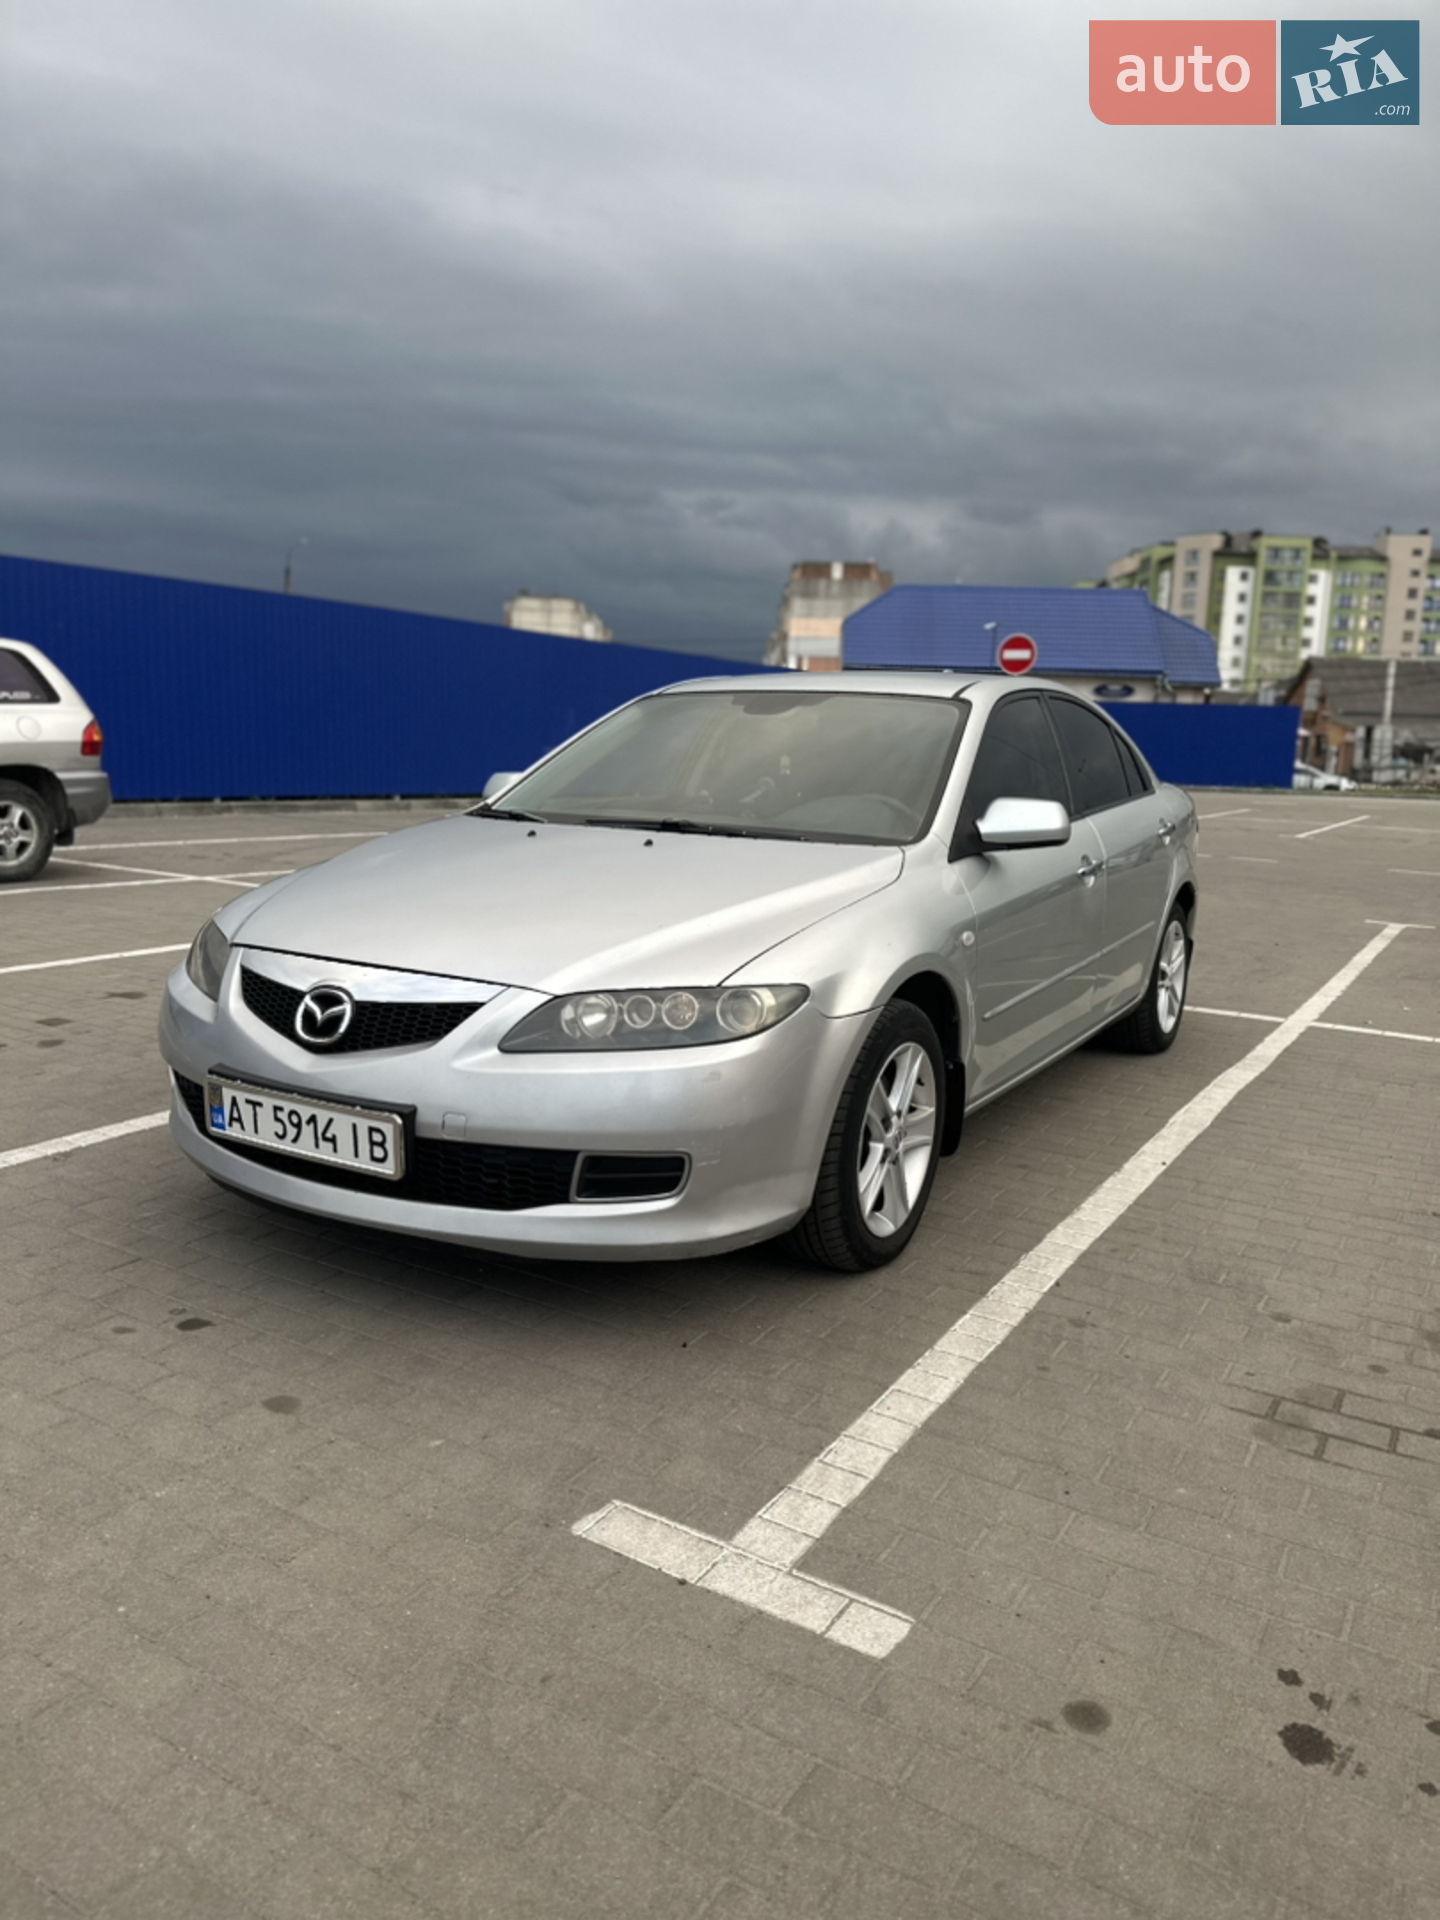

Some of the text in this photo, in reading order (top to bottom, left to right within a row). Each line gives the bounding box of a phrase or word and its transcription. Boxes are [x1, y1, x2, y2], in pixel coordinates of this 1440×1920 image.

[228, 1095, 389, 1164] AT 5914 IB
